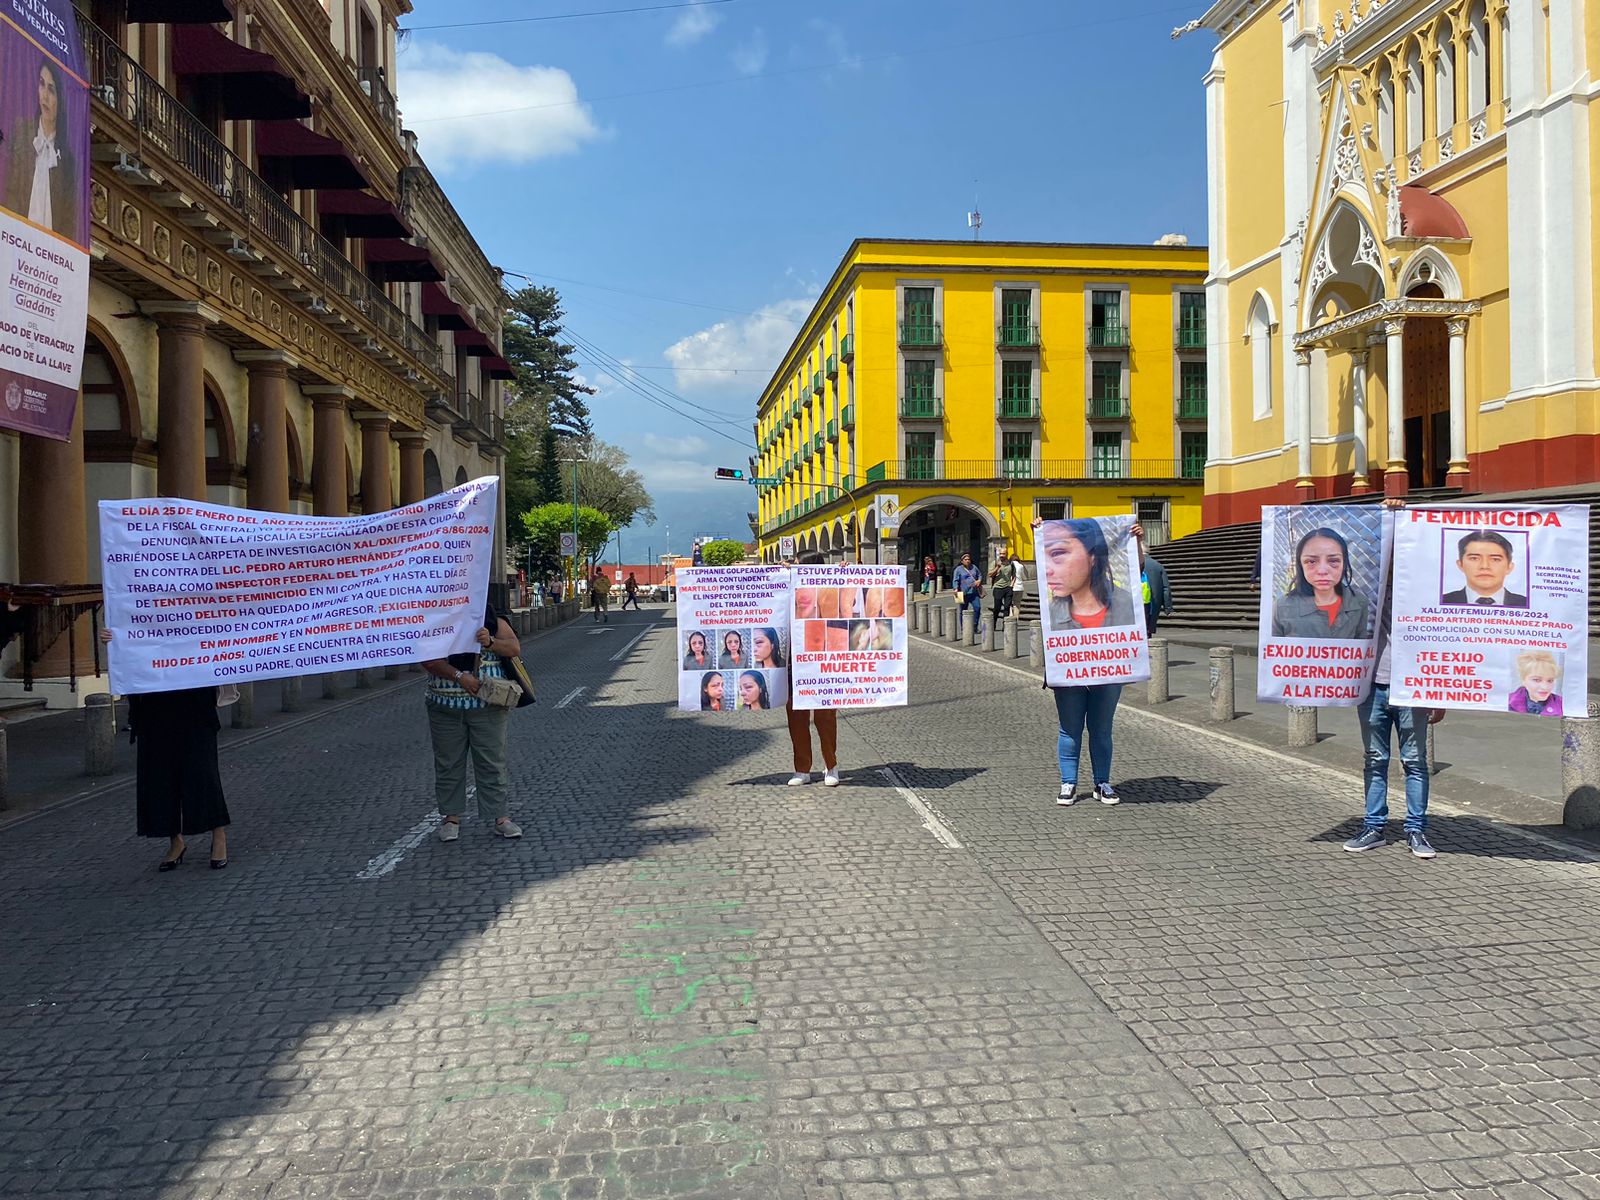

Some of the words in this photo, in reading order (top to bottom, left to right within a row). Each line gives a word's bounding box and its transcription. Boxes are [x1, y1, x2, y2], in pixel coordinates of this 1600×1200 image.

[13, 0, 24, 16] EN
[26, 11, 69, 54] VERACRUZ
[1, 231, 33, 253] FISCAL
[36, 247, 74, 272] GENERAL
[18, 259, 58, 285] Verónica
[10, 274, 62, 303] Hernández
[16, 294, 55, 317] Giadáns
[20, 328, 31, 339] DE
[34, 332, 74, 353] VERACRUZ
[23, 351, 34, 362] DE
[36, 355, 46, 365] LA
[49, 358, 71, 373] LLAVE
[24, 389, 48, 400] VERACRUZ
[122, 507, 136, 515] EL
[163, 507, 176, 515] 25
[178, 507, 193, 515] DE
[196, 510, 234, 522] ENERO
[237, 516, 258, 524] DEL
[1412, 509, 1562, 527] FEMINICIDA
[128, 523, 142, 531] DE
[145, 522, 159, 531] LA
[163, 522, 196, 530] FISCAL
[142, 537, 197, 546] DENUNCIA
[200, 536, 227, 544] ANTE
[402, 519, 427, 529] ESTA
[107, 551, 179, 562] ABRIÉNDOSE
[198, 550, 246, 559] CARPETA
[267, 543, 351, 556] INVESTIGACIÓN
[135, 569, 148, 577] EN
[152, 567, 198, 576] CONTRA
[201, 566, 220, 575] DEL
[247, 562, 285, 572] PEDRO
[289, 559, 334, 569] ARTURO
[834, 567, 873, 575] PRIVADA
[128, 584, 176, 593] TRABAJA
[180, 583, 213, 591] COMO
[283, 571, 334, 584] FEDERAL
[337, 568, 358, 578] DEL
[719, 575, 771, 583] CONTUNDENTE
[875, 577, 896, 585] DÍAS
[153, 596, 216, 607] TENTATIVA
[236, 588, 307, 602] FEMINICIDIO
[131, 615, 153, 623] HOY
[157, 612, 192, 622] DICHO
[195, 609, 237, 619] DELITO
[258, 603, 309, 615] QUEDADO
[148, 629, 164, 637] HA
[166, 624, 232, 636] PROCEDIDO
[305, 622, 352, 635] NOMBRE
[1484, 618, 1540, 626] HERNÁNDEZ
[1542, 622, 1573, 630] PRADO
[1046, 635, 1077, 650] ¡EXIJO
[1080, 632, 1127, 645] JUSTICIA
[1129, 631, 1143, 642] AL
[1518, 629, 1549, 637] MADRE
[1462, 636, 1493, 644] OLIVIA
[1495, 638, 1526, 646] PRADO
[1529, 639, 1567, 649] MONTES
[152, 659, 178, 668] HIJO
[299, 636, 363, 651] ENCUENTRA
[829, 652, 887, 661] AMENAZAS
[889, 652, 903, 660] DE
[1056, 648, 1129, 663] GOBERNADOR
[1131, 647, 1139, 657] Y
[1263, 644, 1303, 659] ¡EXIJO
[1306, 646, 1362, 660] JUSTICIA
[1364, 647, 1374, 659] AL
[1416, 652, 1438, 663] ¡TE
[1442, 652, 1484, 663] EXIJO
[215, 666, 236, 676] CON
[296, 656, 328, 667] QUIEN
[820, 662, 876, 673] MUERTE
[1066, 669, 1073, 679] A
[1075, 668, 1089, 678] LA
[1091, 664, 1132, 677] FISCAL!
[1272, 664, 1361, 679] GOBERNADOR
[1363, 666, 1369, 678] Y
[1421, 665, 1449, 675] QUE
[1453, 666, 1476, 675] ME
[1405, 677, 1493, 689] ENTREGUES
[1283, 684, 1292, 696] A
[1295, 685, 1311, 697] LA
[1314, 686, 1360, 699] FISCAL!
[1412, 690, 1422, 699] A
[1426, 691, 1442, 700] MI
[1446, 690, 1487, 702] NIÑO!
